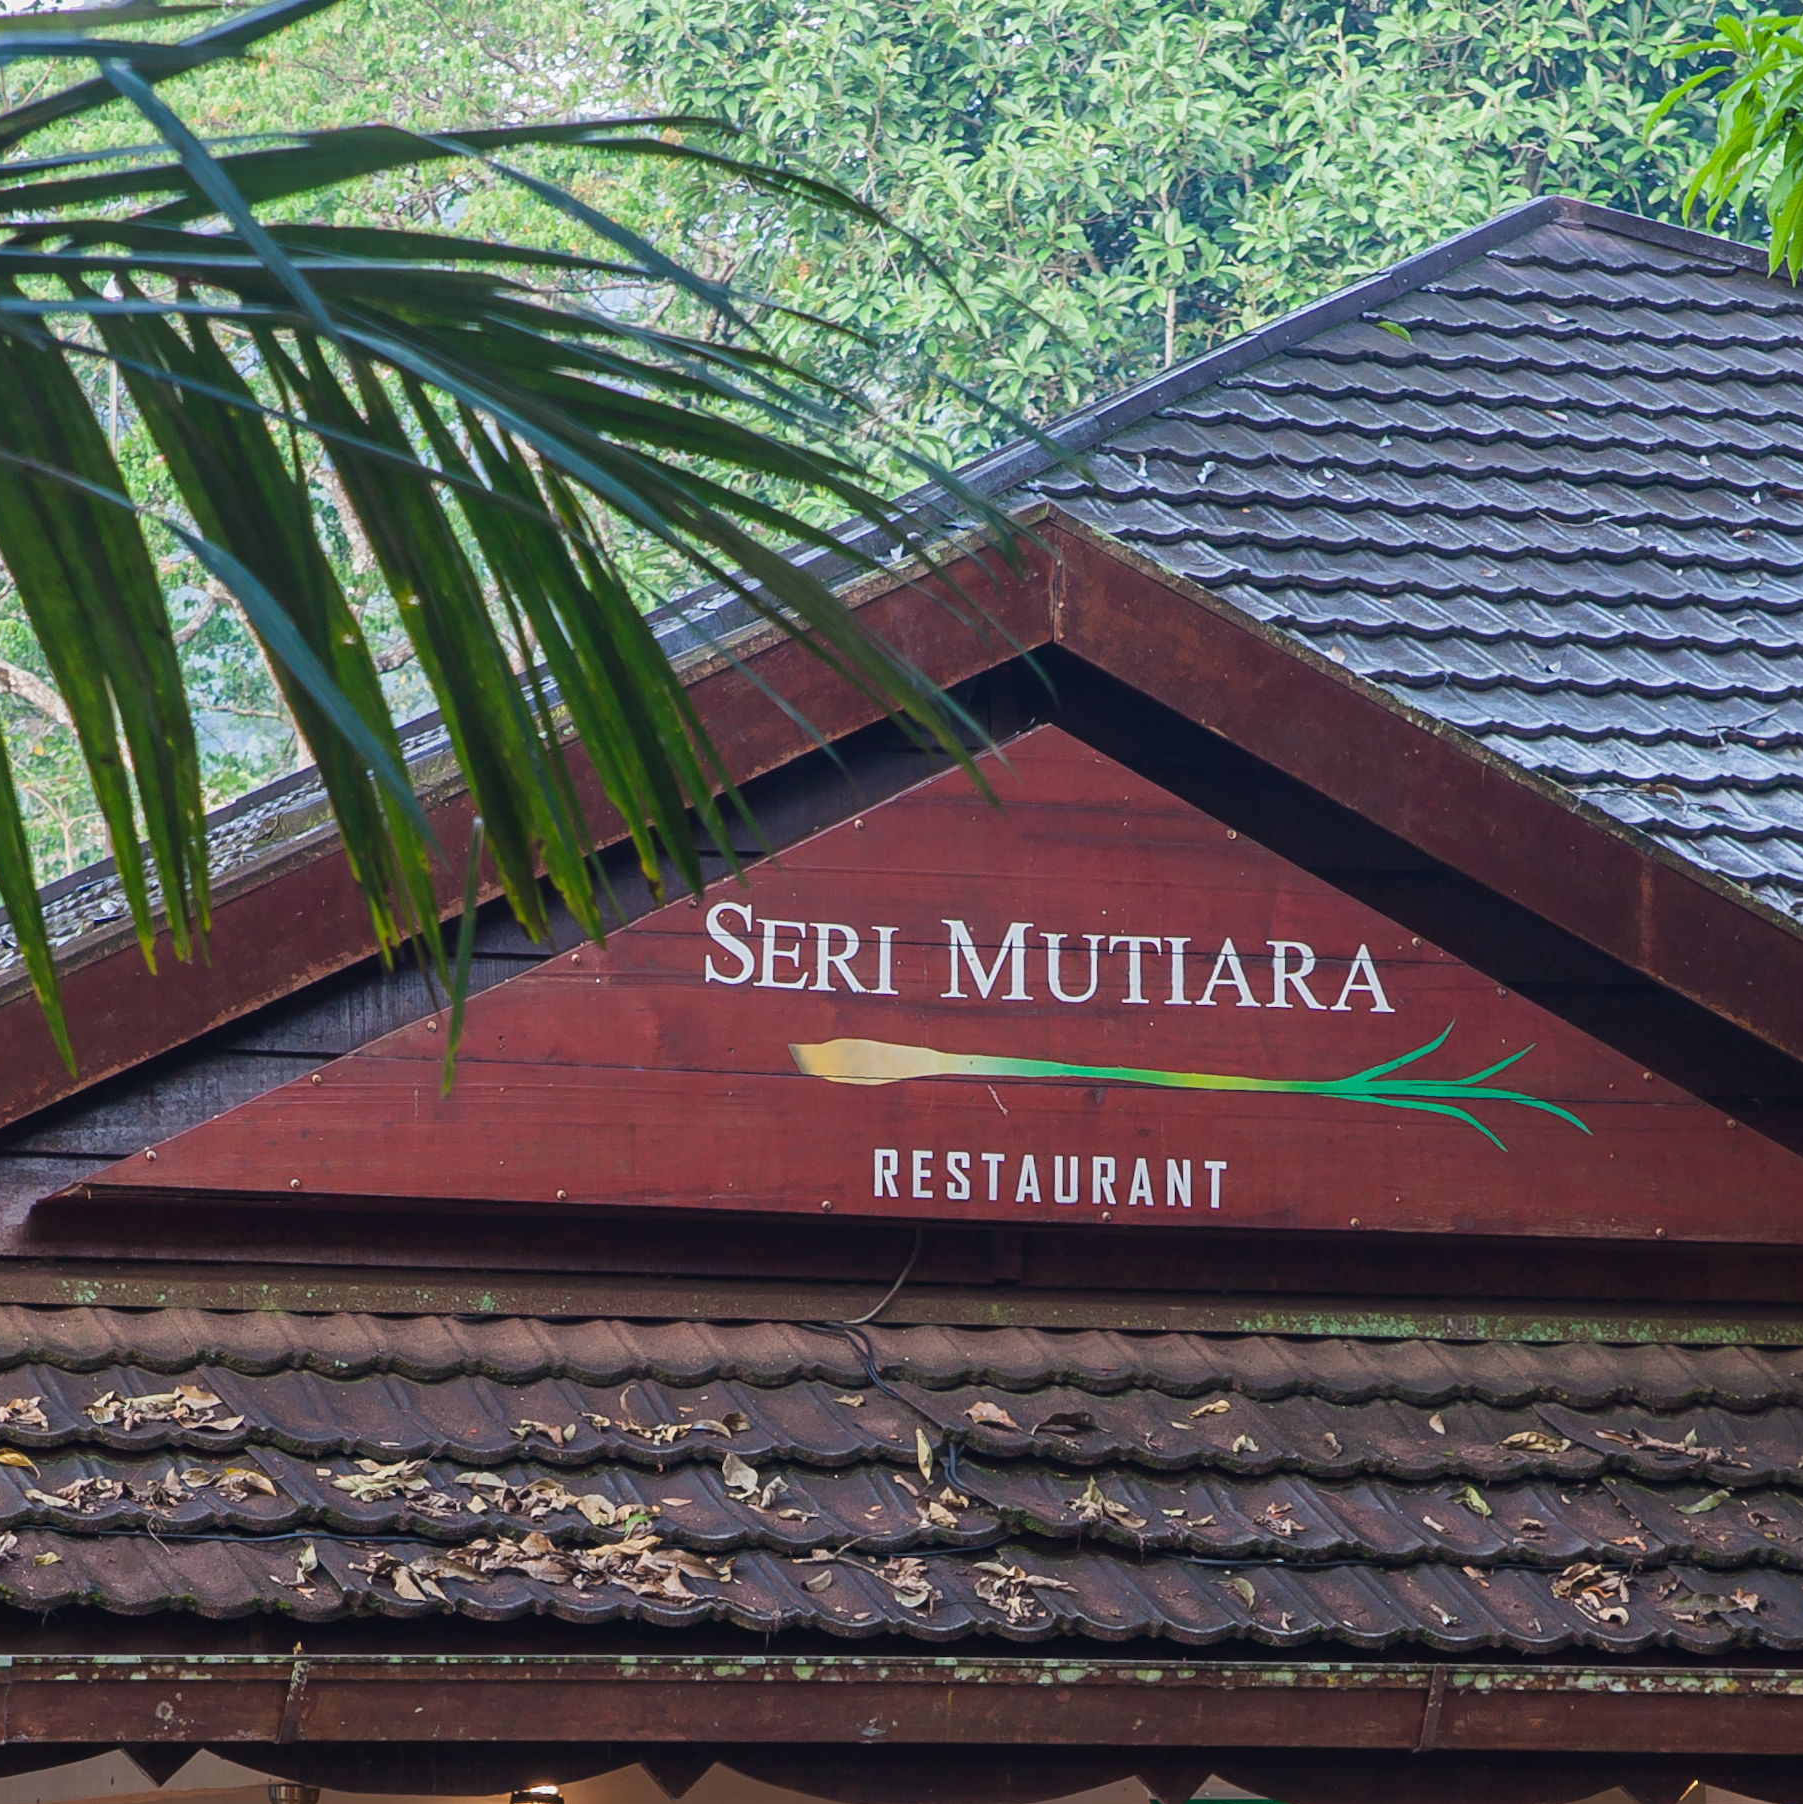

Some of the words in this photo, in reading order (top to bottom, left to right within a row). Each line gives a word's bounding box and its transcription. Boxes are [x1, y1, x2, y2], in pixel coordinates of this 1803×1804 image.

[705, 902, 901, 997] SERI
[941, 918, 1395, 1014] MUTIARA
[873, 1147, 1229, 1210] RESTAURANT
